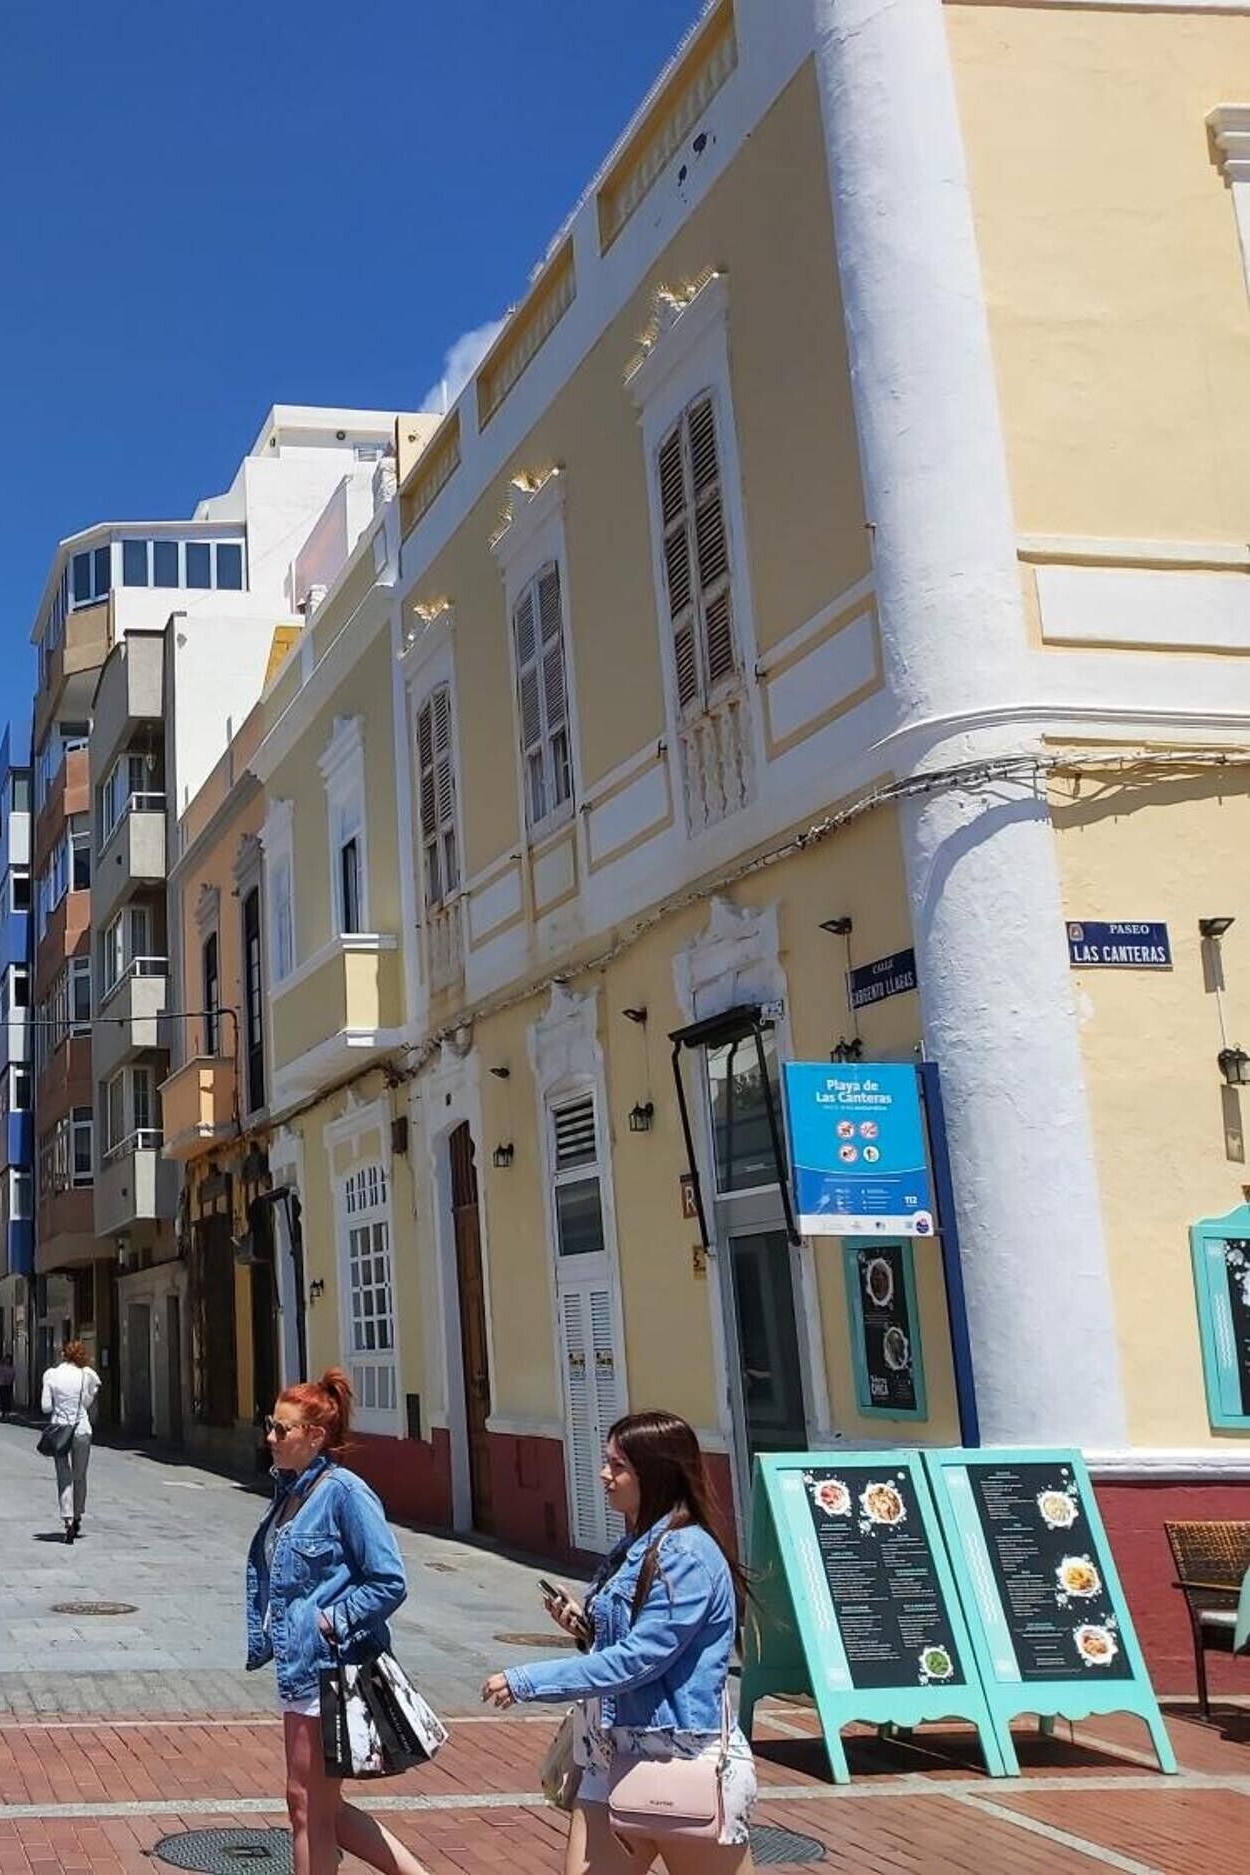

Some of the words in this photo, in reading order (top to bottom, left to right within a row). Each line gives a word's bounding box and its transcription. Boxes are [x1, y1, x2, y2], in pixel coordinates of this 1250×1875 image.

[1110, 925, 1150, 934] PASEO
[1073, 946, 1098, 961] LAS
[1102, 946, 1166, 962] CANTERAS
[826, 1080, 860, 1093] Playa
[863, 1080, 879, 1090] de
[816, 1091, 835, 1102] Las
[837, 1092, 892, 1104] Canteras
